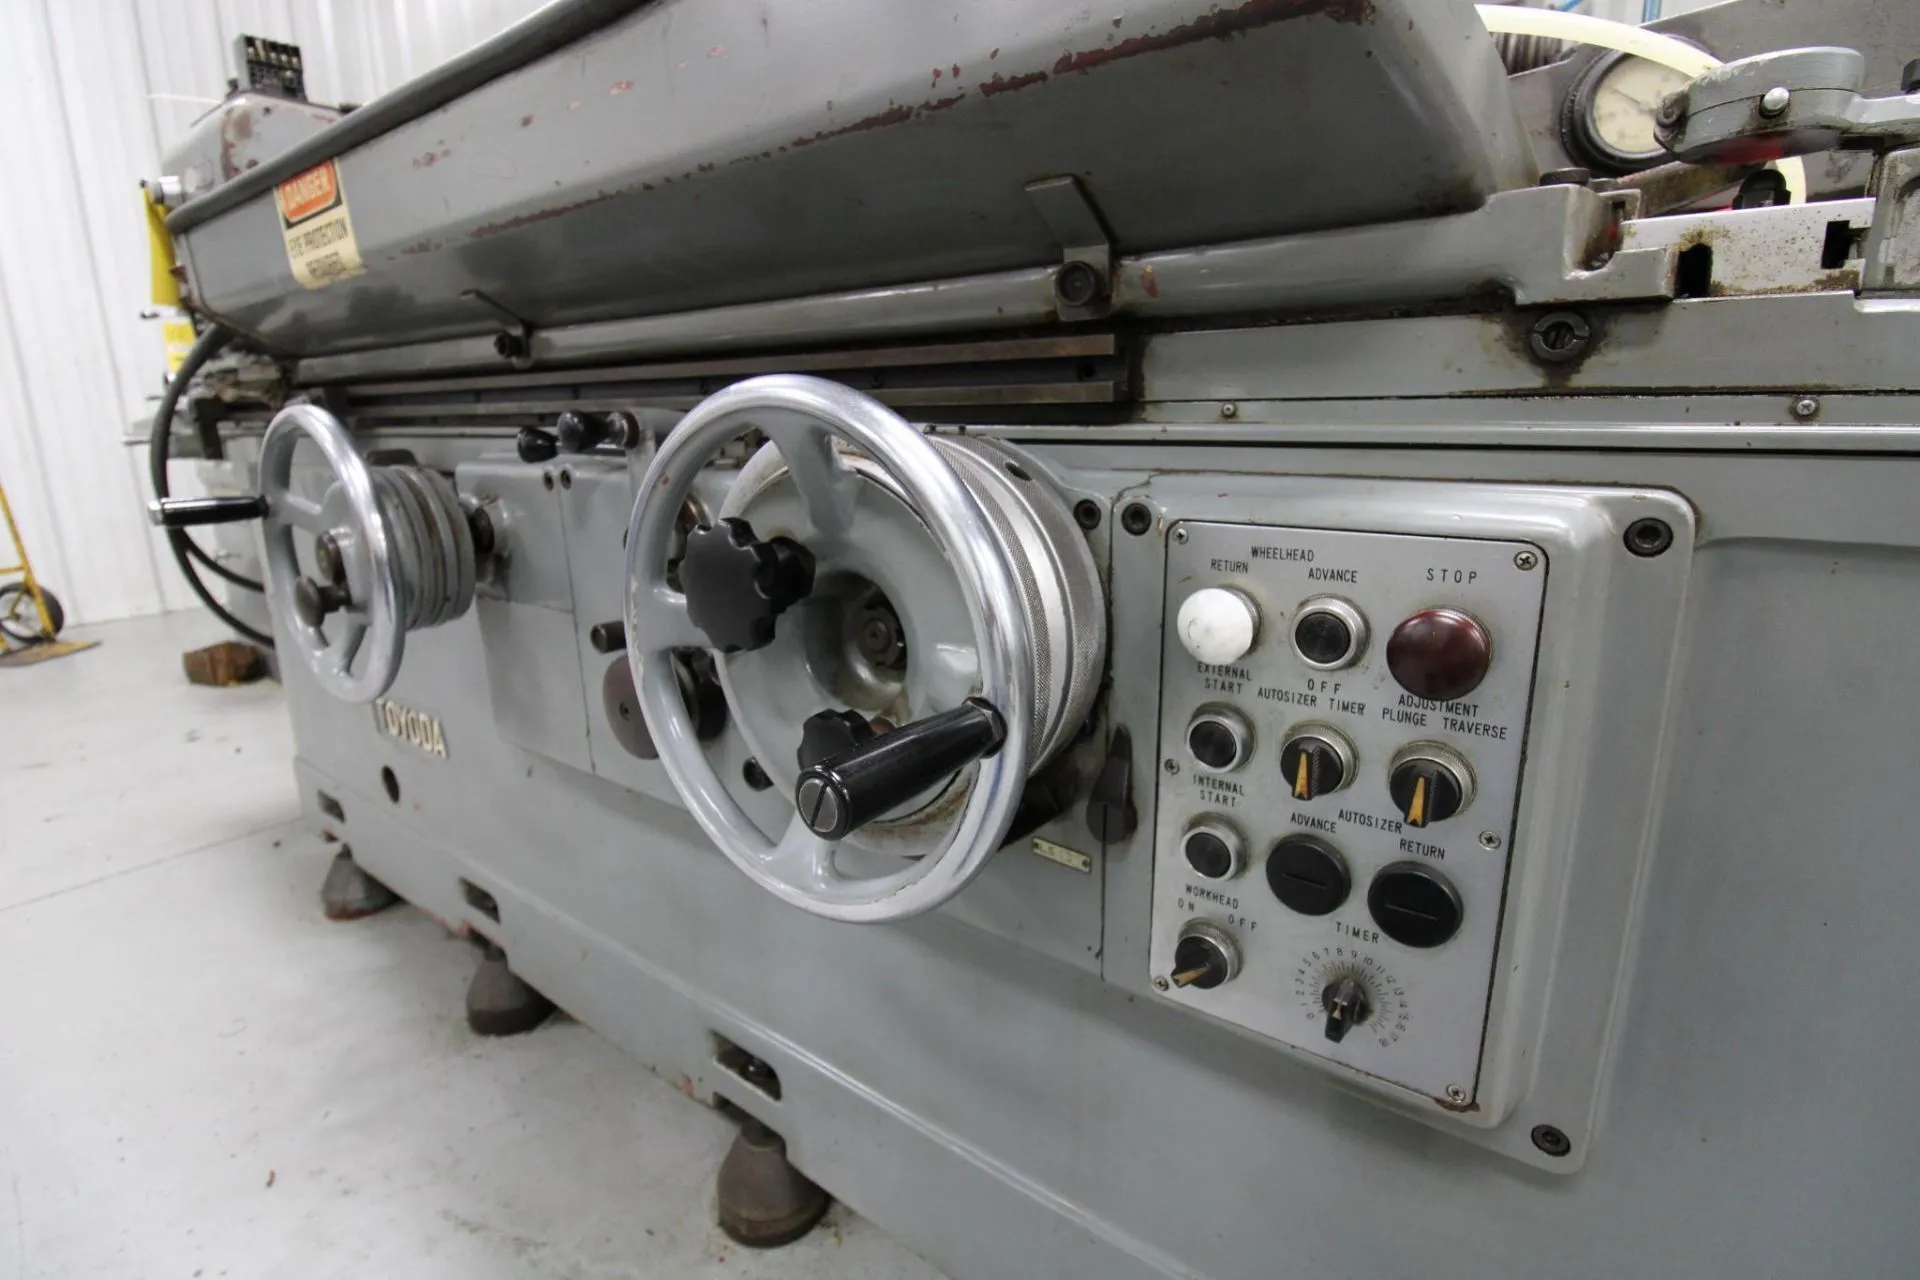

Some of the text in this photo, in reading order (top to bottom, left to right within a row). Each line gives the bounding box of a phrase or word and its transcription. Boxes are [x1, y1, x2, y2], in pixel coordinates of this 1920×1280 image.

[1251, 545, 1315, 562] WHEELHEAD
[1211, 558, 1249, 574] RETURN
[1308, 567, 1358, 583] ADVANCE
[1426, 567, 1478, 585] STOP
[1197, 663, 1252, 682] EXTERNAL
[1204, 677, 1243, 695] START
[1307, 678, 1341, 694] OFF
[1257, 686, 1365, 716] AUTOSIZER TIMER
[1398, 694, 1479, 717] ADJUSTMENT
[375, 697, 447, 759] TOYODA
[1382, 707, 1508, 741] PLUNGE TRAVERSE
[1193, 774, 1245, 797] INTERNAL
[1200, 789, 1237, 808] START
[1290, 812, 1337, 834] ADVANCE
[1338, 808, 1403, 834] AUTOSIZER
[1399, 837, 1445, 860] RETURN
[1185, 883, 1239, 909] WORKHEAD
[1178, 897, 1257, 932] ON OFF
[1336, 920, 1380, 944] TIMER
[1336, 947, 1343, 957] 8
[1351, 950, 1358, 959] 9
